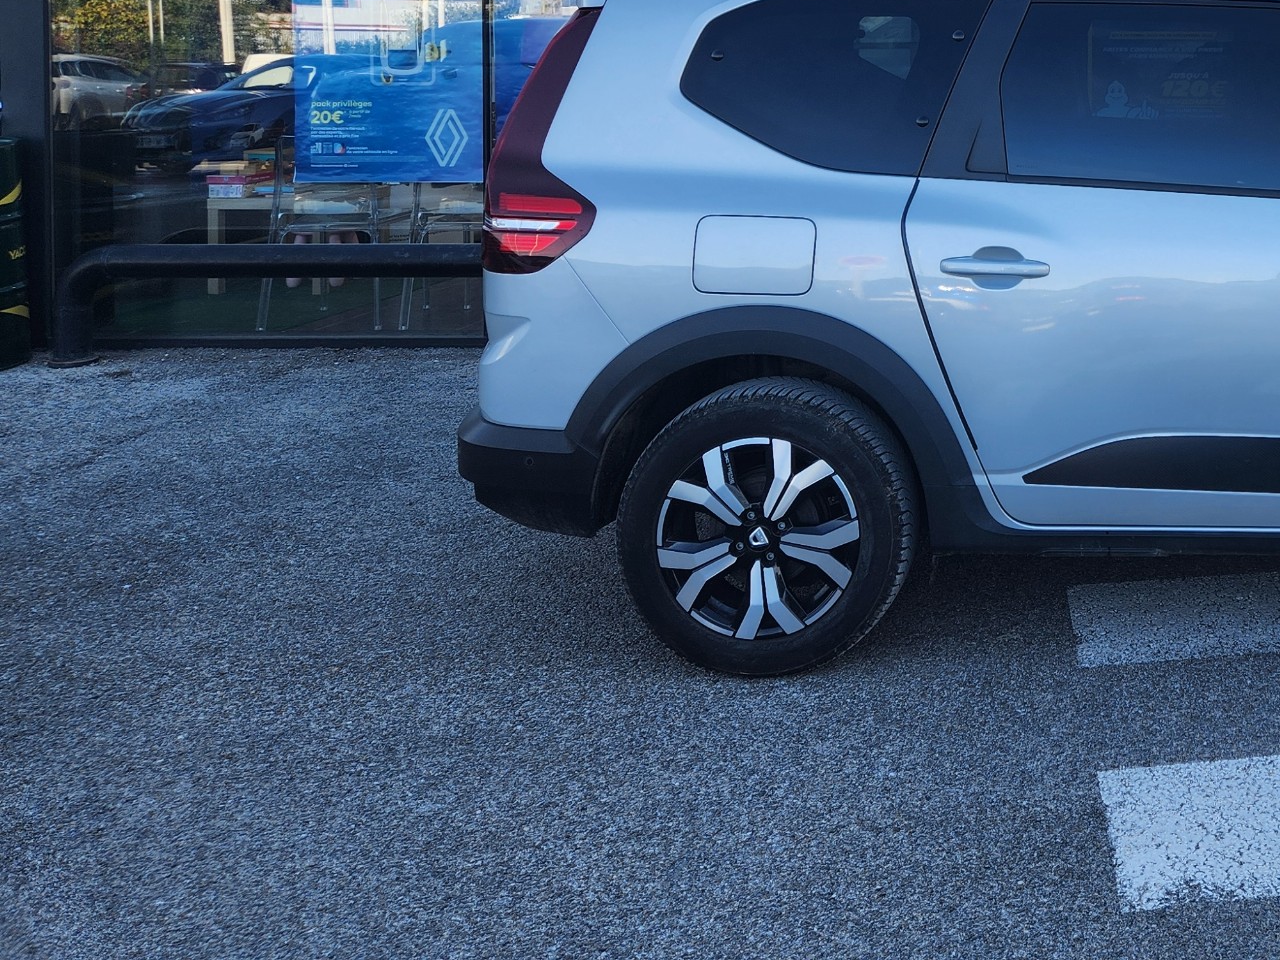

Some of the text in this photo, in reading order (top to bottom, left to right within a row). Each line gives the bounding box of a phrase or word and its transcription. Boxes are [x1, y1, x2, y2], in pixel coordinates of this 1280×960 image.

[311, 100, 373, 109] pack privilèges
[310, 110, 345, 124] 20€
